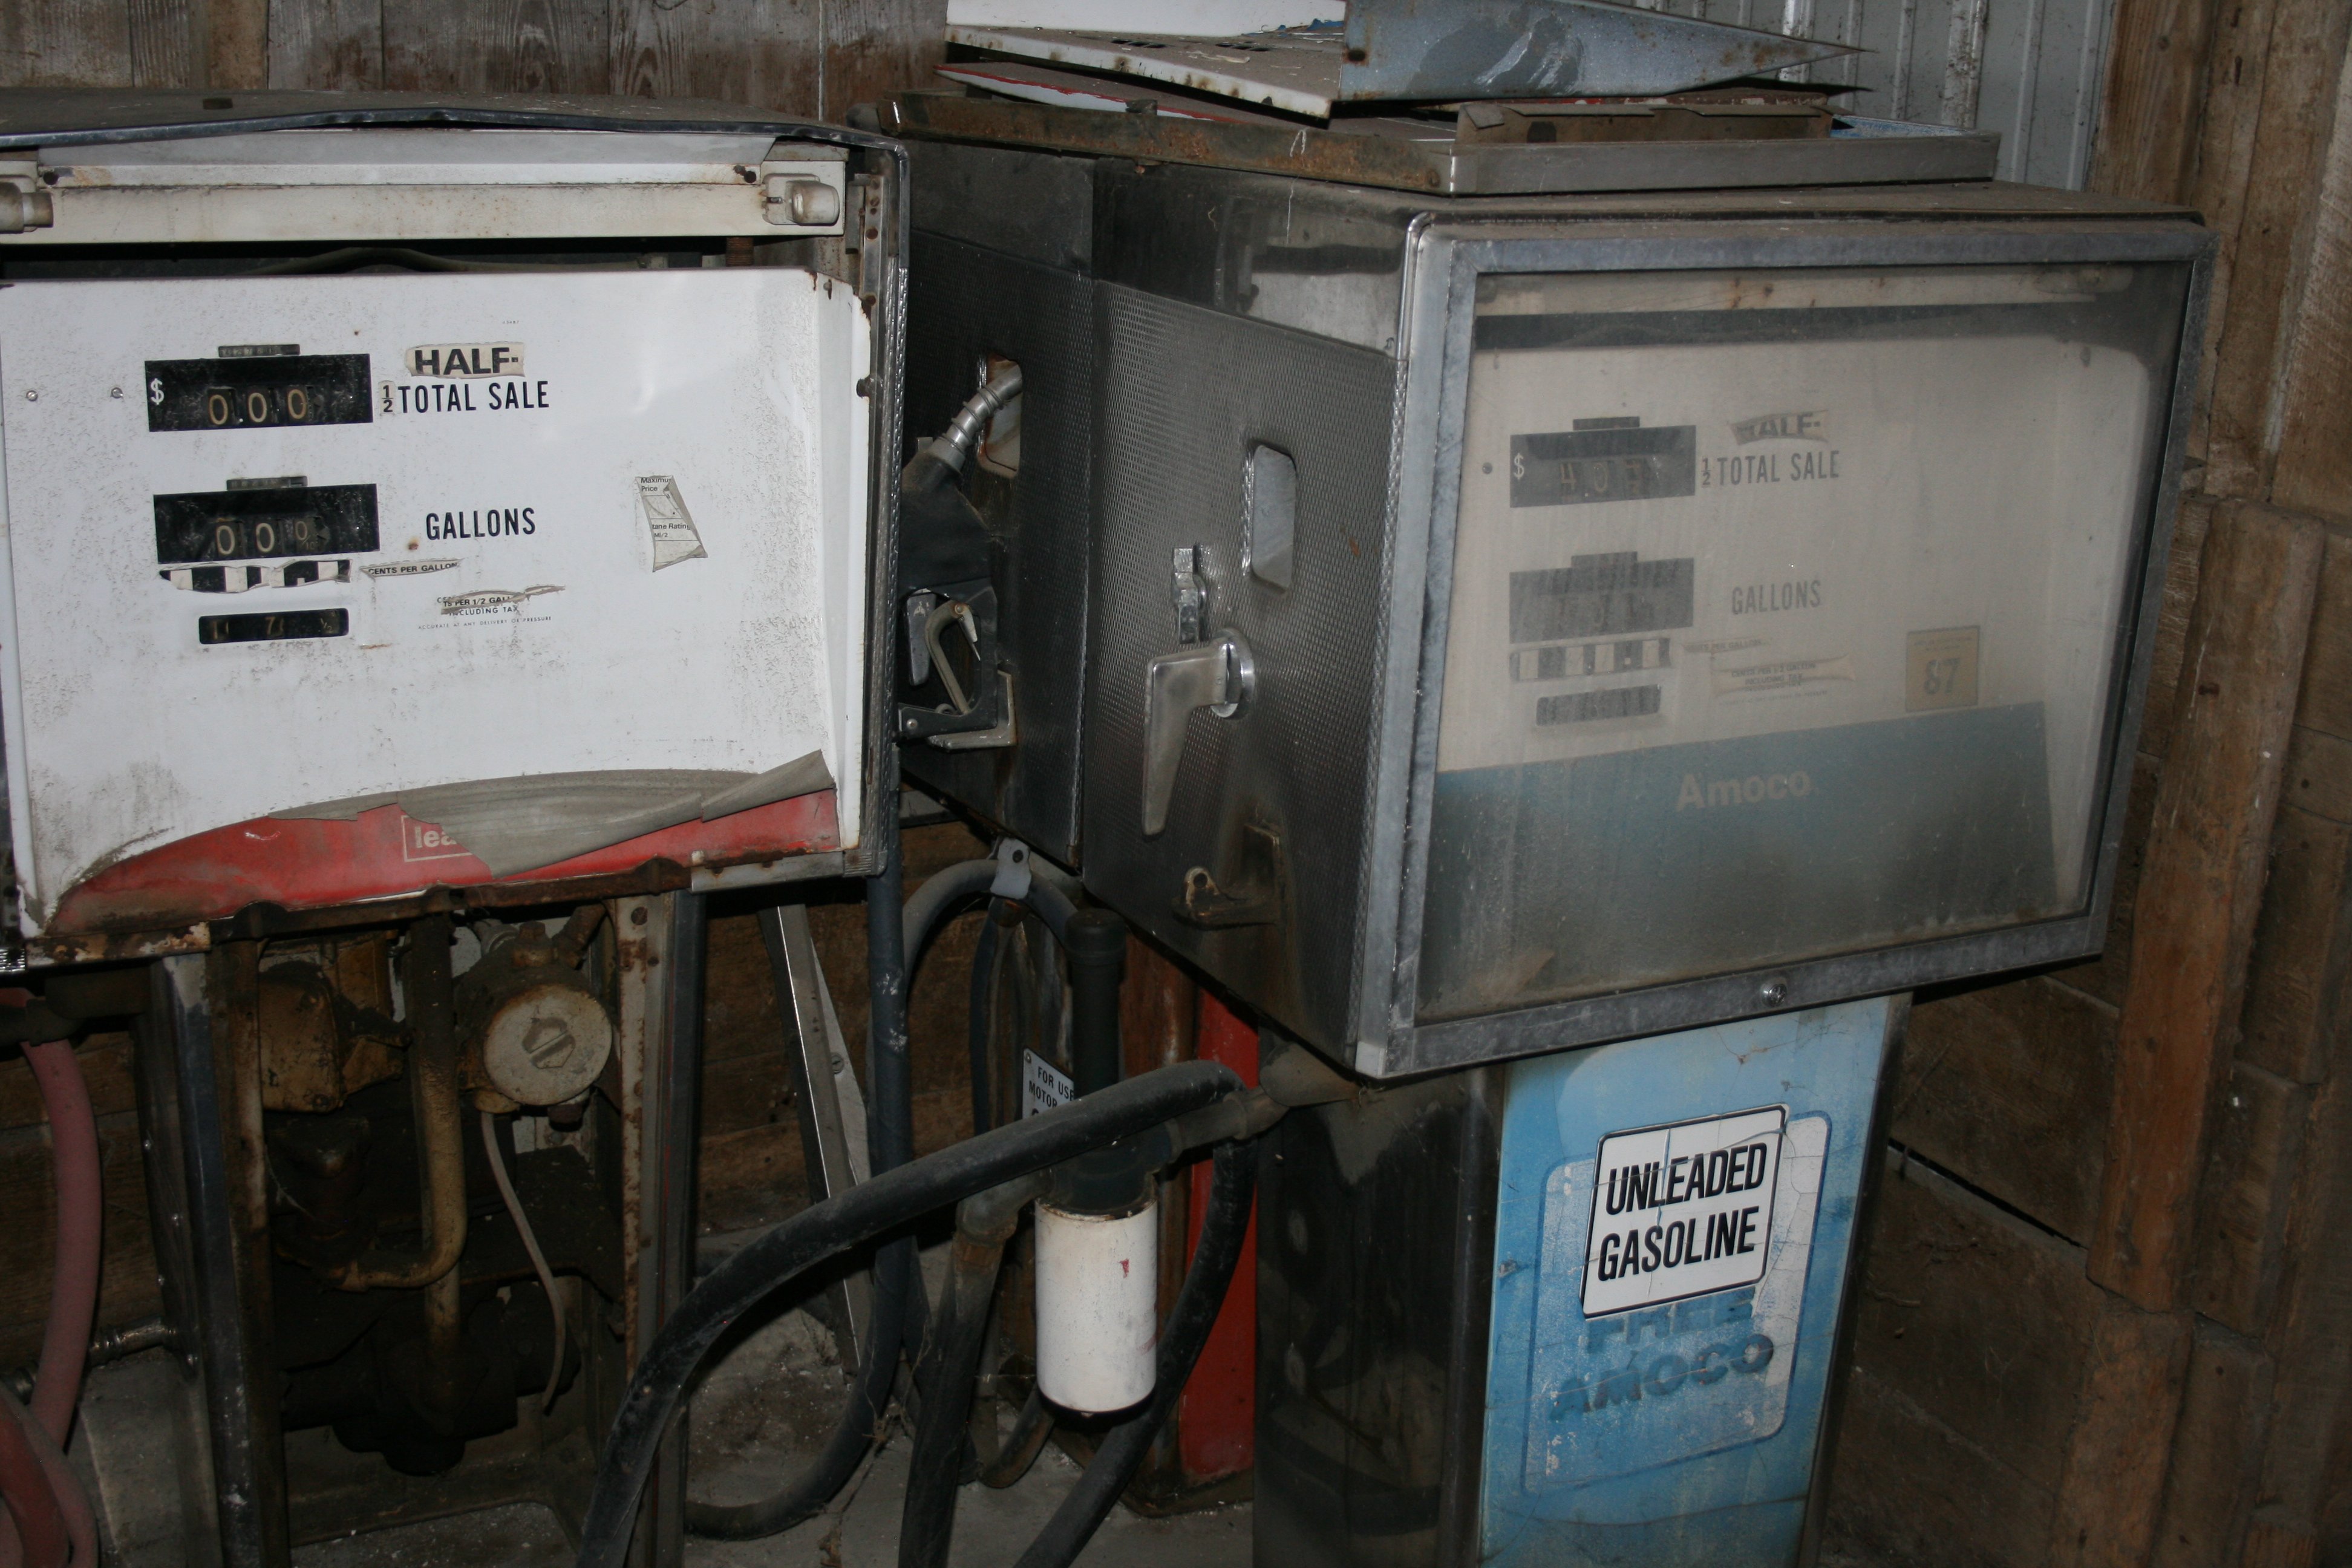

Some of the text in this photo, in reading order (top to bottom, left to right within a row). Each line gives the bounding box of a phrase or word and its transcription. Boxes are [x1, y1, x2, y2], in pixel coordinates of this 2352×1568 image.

[151, 378, 165, 405] $
[397, 384, 477, 414] TOTAL
[488, 381, 550, 410] SALE
[1717, 455, 1780, 486] TOTAL
[1789, 450, 1840, 481] SALE
[426, 508, 537, 541] GALLONS
[368, 567, 397, 575] CENTS
[1731, 580, 1822, 615] GALLONS
[1676, 771, 1811, 811] Amoco
[1038, 1066, 1054, 1088] FOR
[1029, 1080, 1057, 1108] MOTOR
[1605, 1143, 1767, 1215] UNLEADED
[1598, 1206, 1759, 1281] GASOLINE
